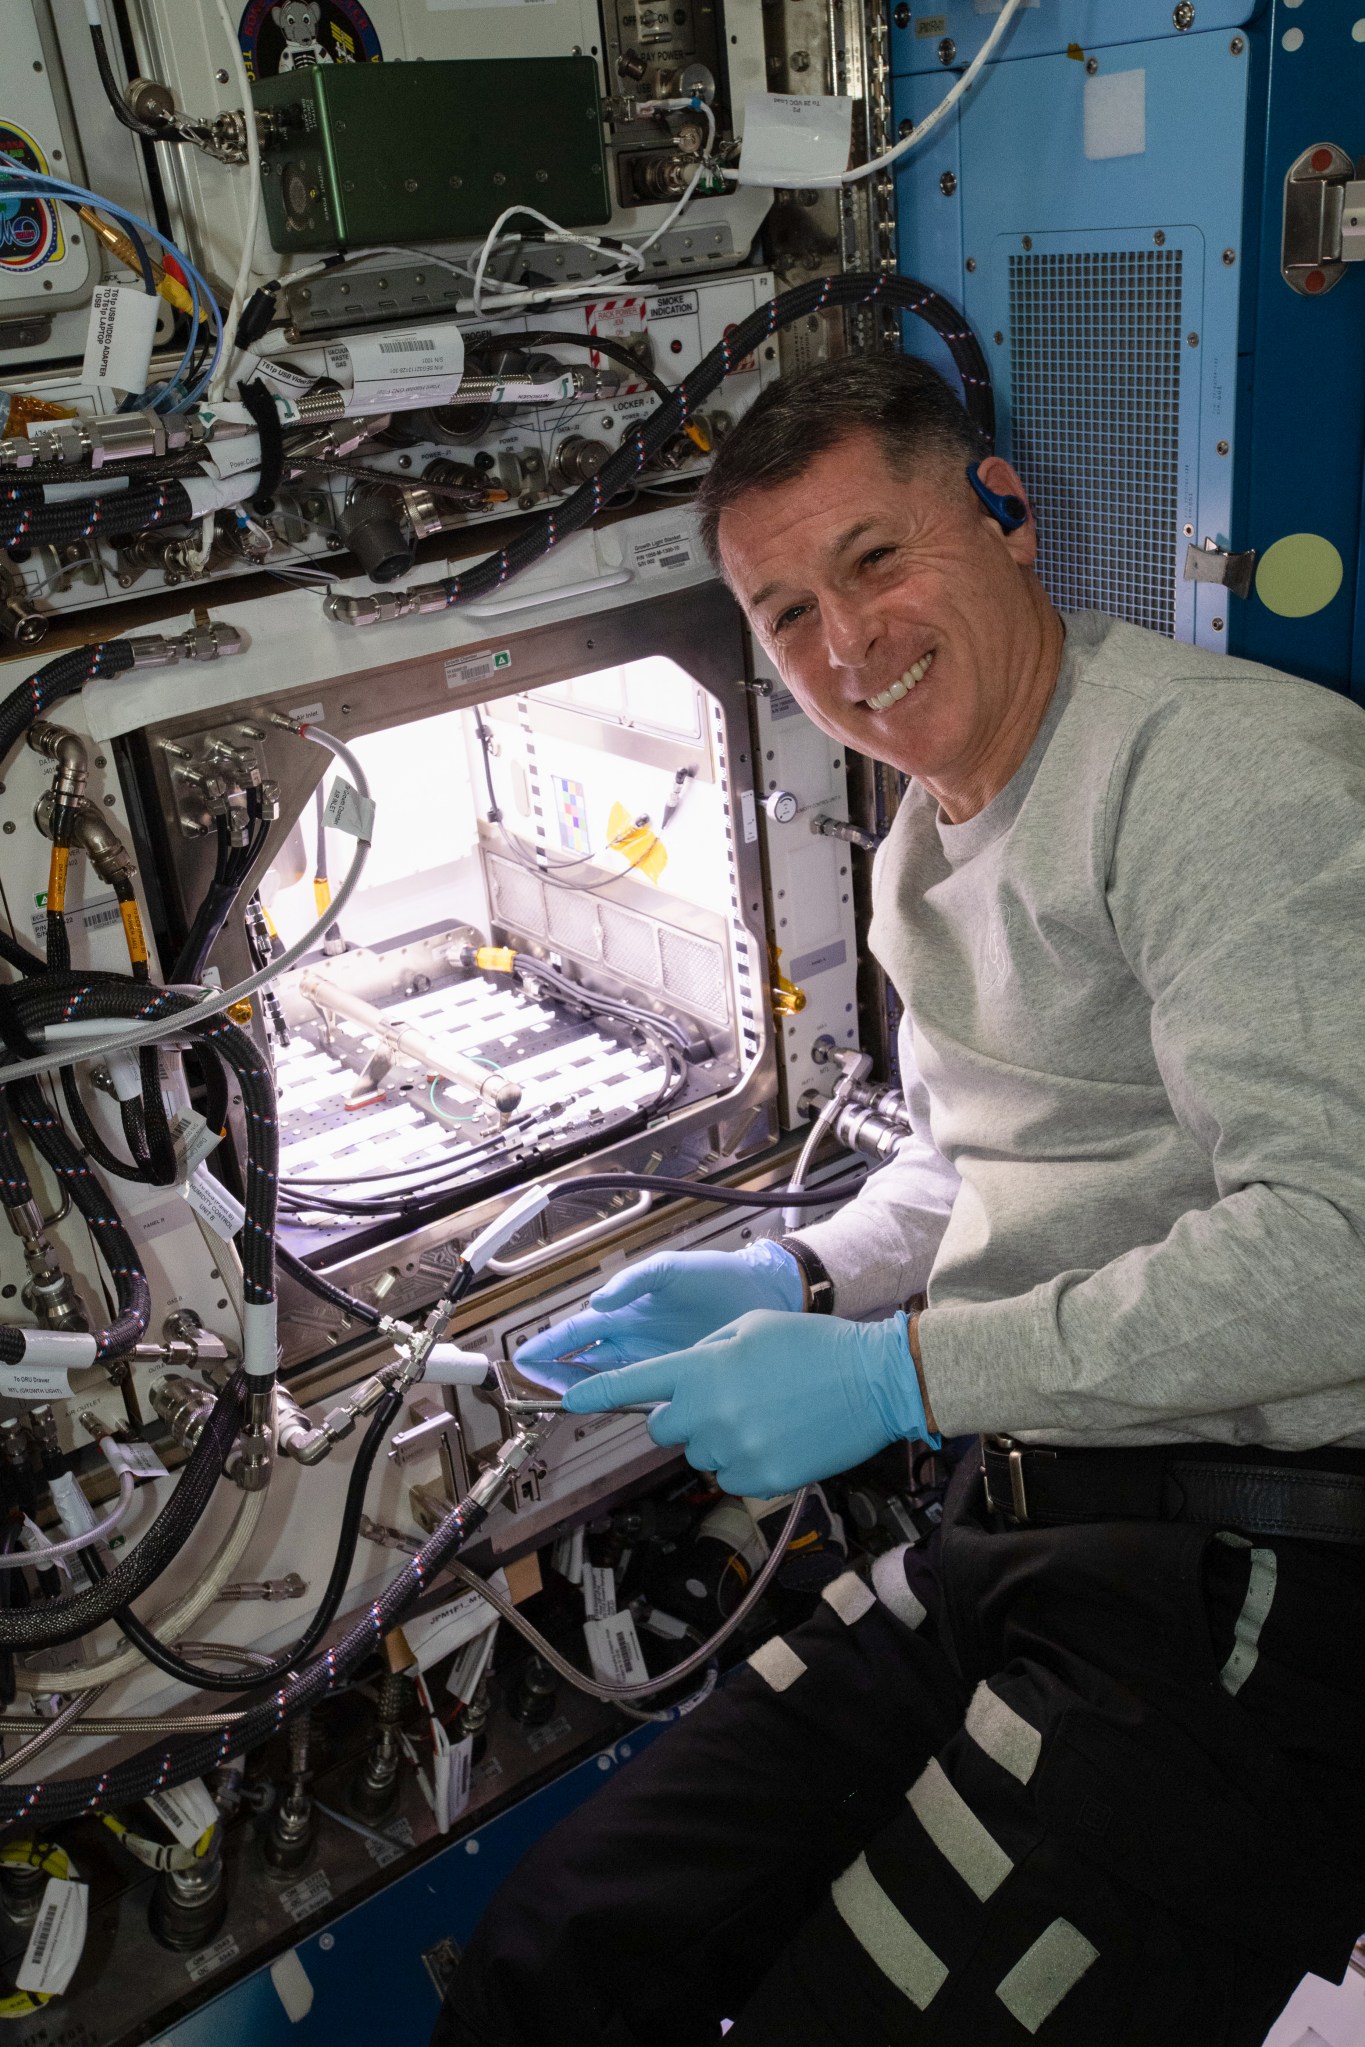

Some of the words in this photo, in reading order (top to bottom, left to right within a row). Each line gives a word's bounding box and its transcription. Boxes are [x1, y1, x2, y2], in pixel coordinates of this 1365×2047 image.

[658, 14, 669, 24] ON
[658, 50, 684, 61] POWER
[760, 278, 768, 286] F2
[102, 288, 111, 298] TO
[110, 288, 120, 306] T61p
[94, 293, 103, 308] USB
[657, 294, 685, 307] SMOKE
[100, 298, 110, 316] T61p
[650, 304, 694, 317] INDICATION
[109, 307, 118, 322] USB
[598, 311, 613, 320] RACK
[613, 307, 637, 318] POWER
[97, 316, 107, 345] LAPTOP
[104, 322, 114, 344] VIDEO
[460, 329, 493, 341] TROGEN
[98, 345, 110, 377] ADAPTER
[330, 354, 350, 362] WASTE
[261, 360, 278, 374] T61p
[277, 369, 292, 381] USB
[335, 360, 348, 369] GAS
[613, 400, 646, 412] LOCKER
[499, 436, 519, 445] POWER
[229, 461, 245, 469] Power
[305, 710, 319, 720] Inlet
[39, 758, 55, 767] DATA
[328, 799, 337, 814] INLET
[34, 923, 48, 933] P/N
[189, 1183, 213, 1209] HUMIDITY
[210, 1206, 234, 1231] CONTROL
[198, 1203, 211, 1218] UNIT
[208, 1214, 216, 1222] B
[142, 1219, 159, 1230] PANEL
[148, 1363, 166, 1374] OUTLE
[65, 1409, 76, 1419] AIR
